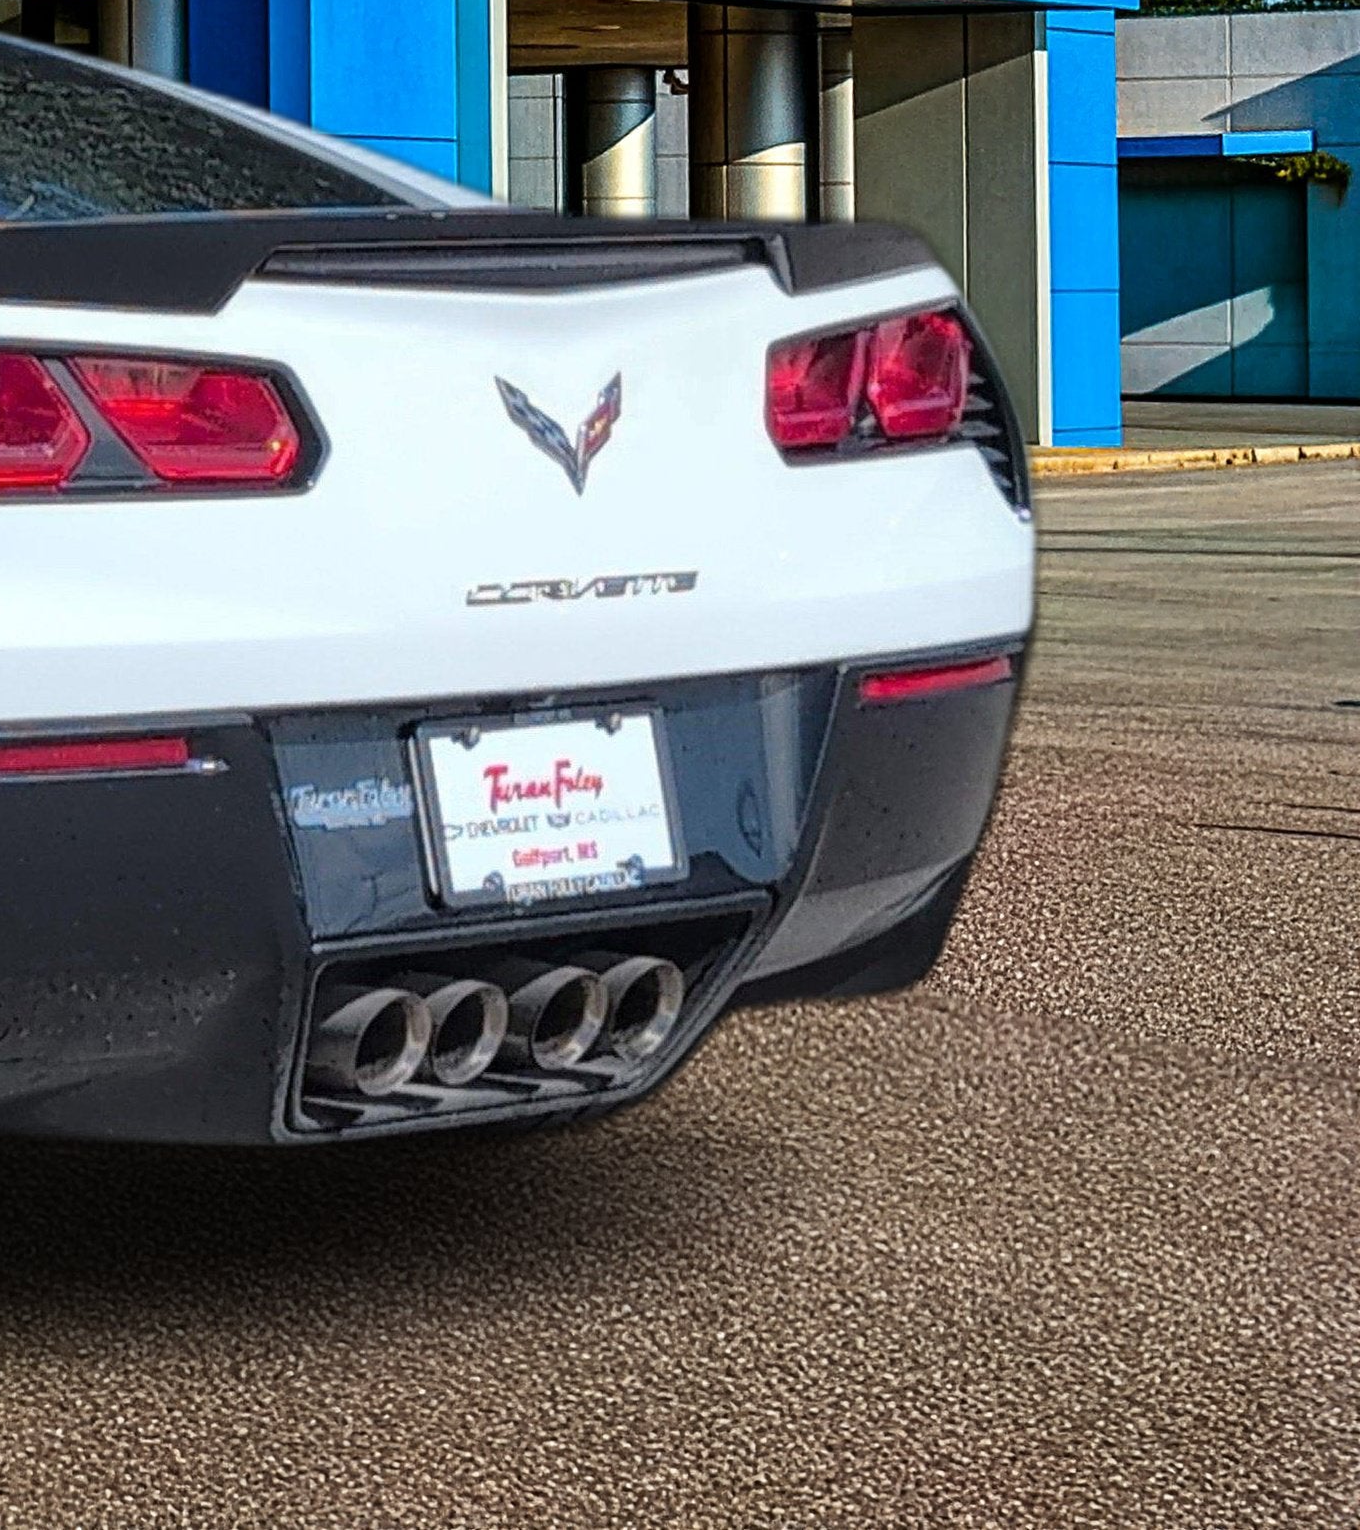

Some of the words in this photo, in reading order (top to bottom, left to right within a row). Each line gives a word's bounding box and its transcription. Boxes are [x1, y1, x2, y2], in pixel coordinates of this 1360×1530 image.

[482, 763, 552, 814] Turan
[553, 758, 604, 809] Foley
[574, 803, 660, 826] CADILLAC
